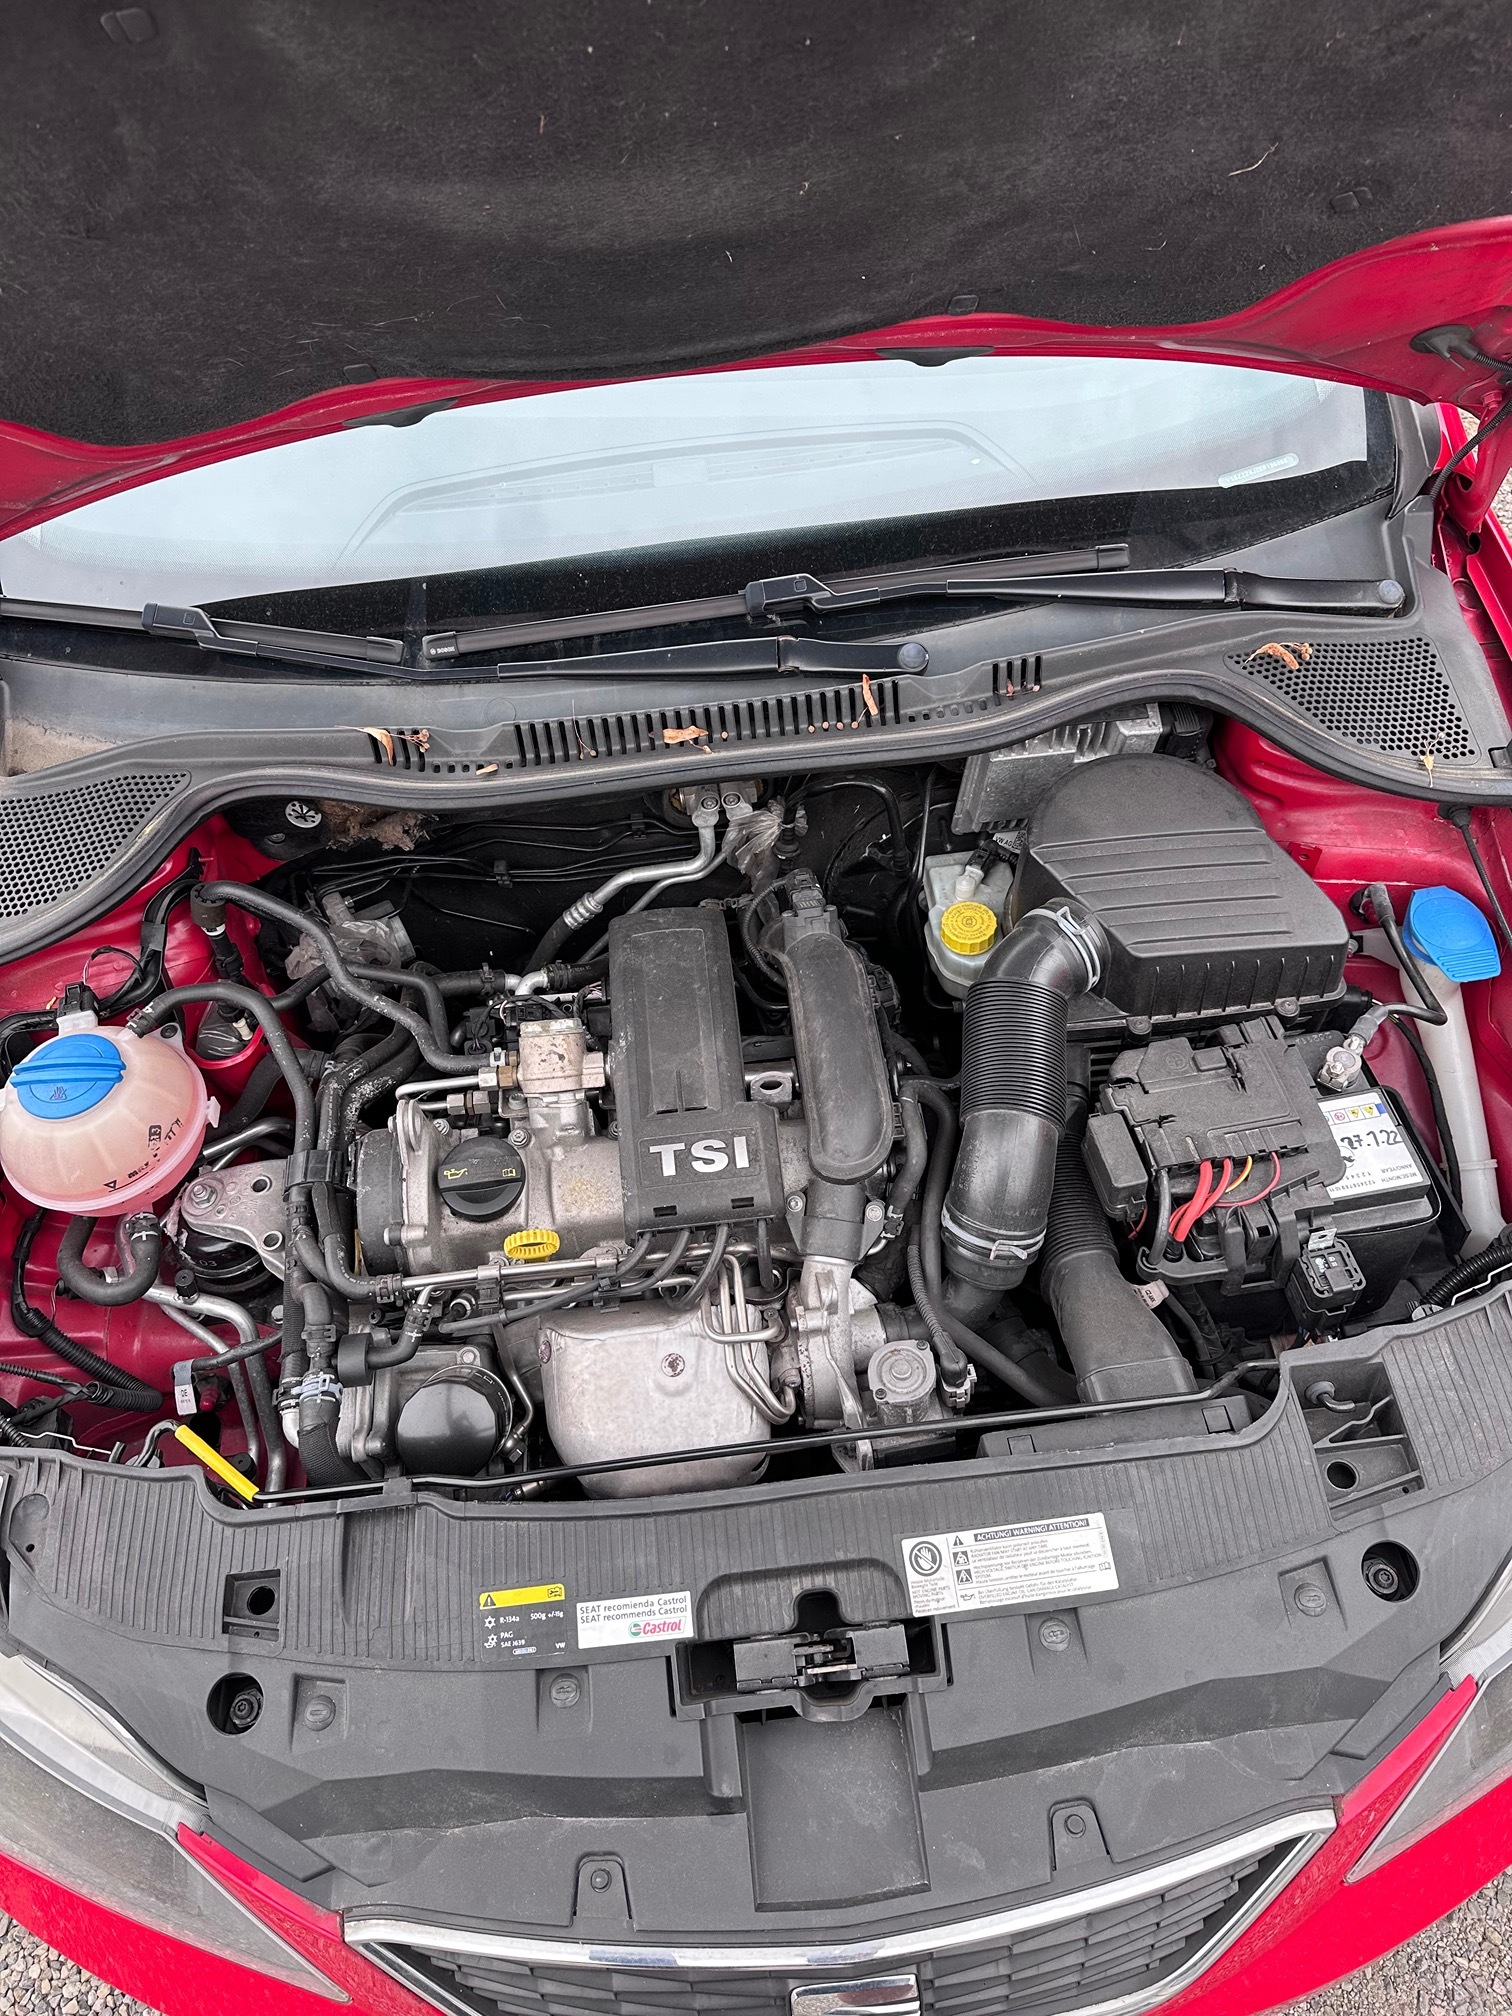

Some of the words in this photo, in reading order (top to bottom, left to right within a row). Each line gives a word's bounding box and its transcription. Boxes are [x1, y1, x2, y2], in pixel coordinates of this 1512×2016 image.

[1340, 1129, 1404, 1149] 27.1.22
[649, 1136, 750, 1177] TSI
[977, 1530, 1012, 1540] ACHTUNG!
[1012, 1525, 1048, 1535] WARNING!
[1048, 1520, 1088, 1531] ATTENTION!
[580, 1605, 602, 1614] SEAT
[603, 1599, 655, 1612] recomienda
[657, 1596, 687, 1606] Castrol
[499, 1615, 520, 1624] R-134a
[530, 1611, 547, 1622] 500g
[580, 1614, 601, 1624] SEAT
[603, 1608, 657, 1621] recommends
[658, 1605, 688, 1615] Castrol
[500, 1631, 514, 1639] PAG
[642, 1619, 683, 1635] Castrol
